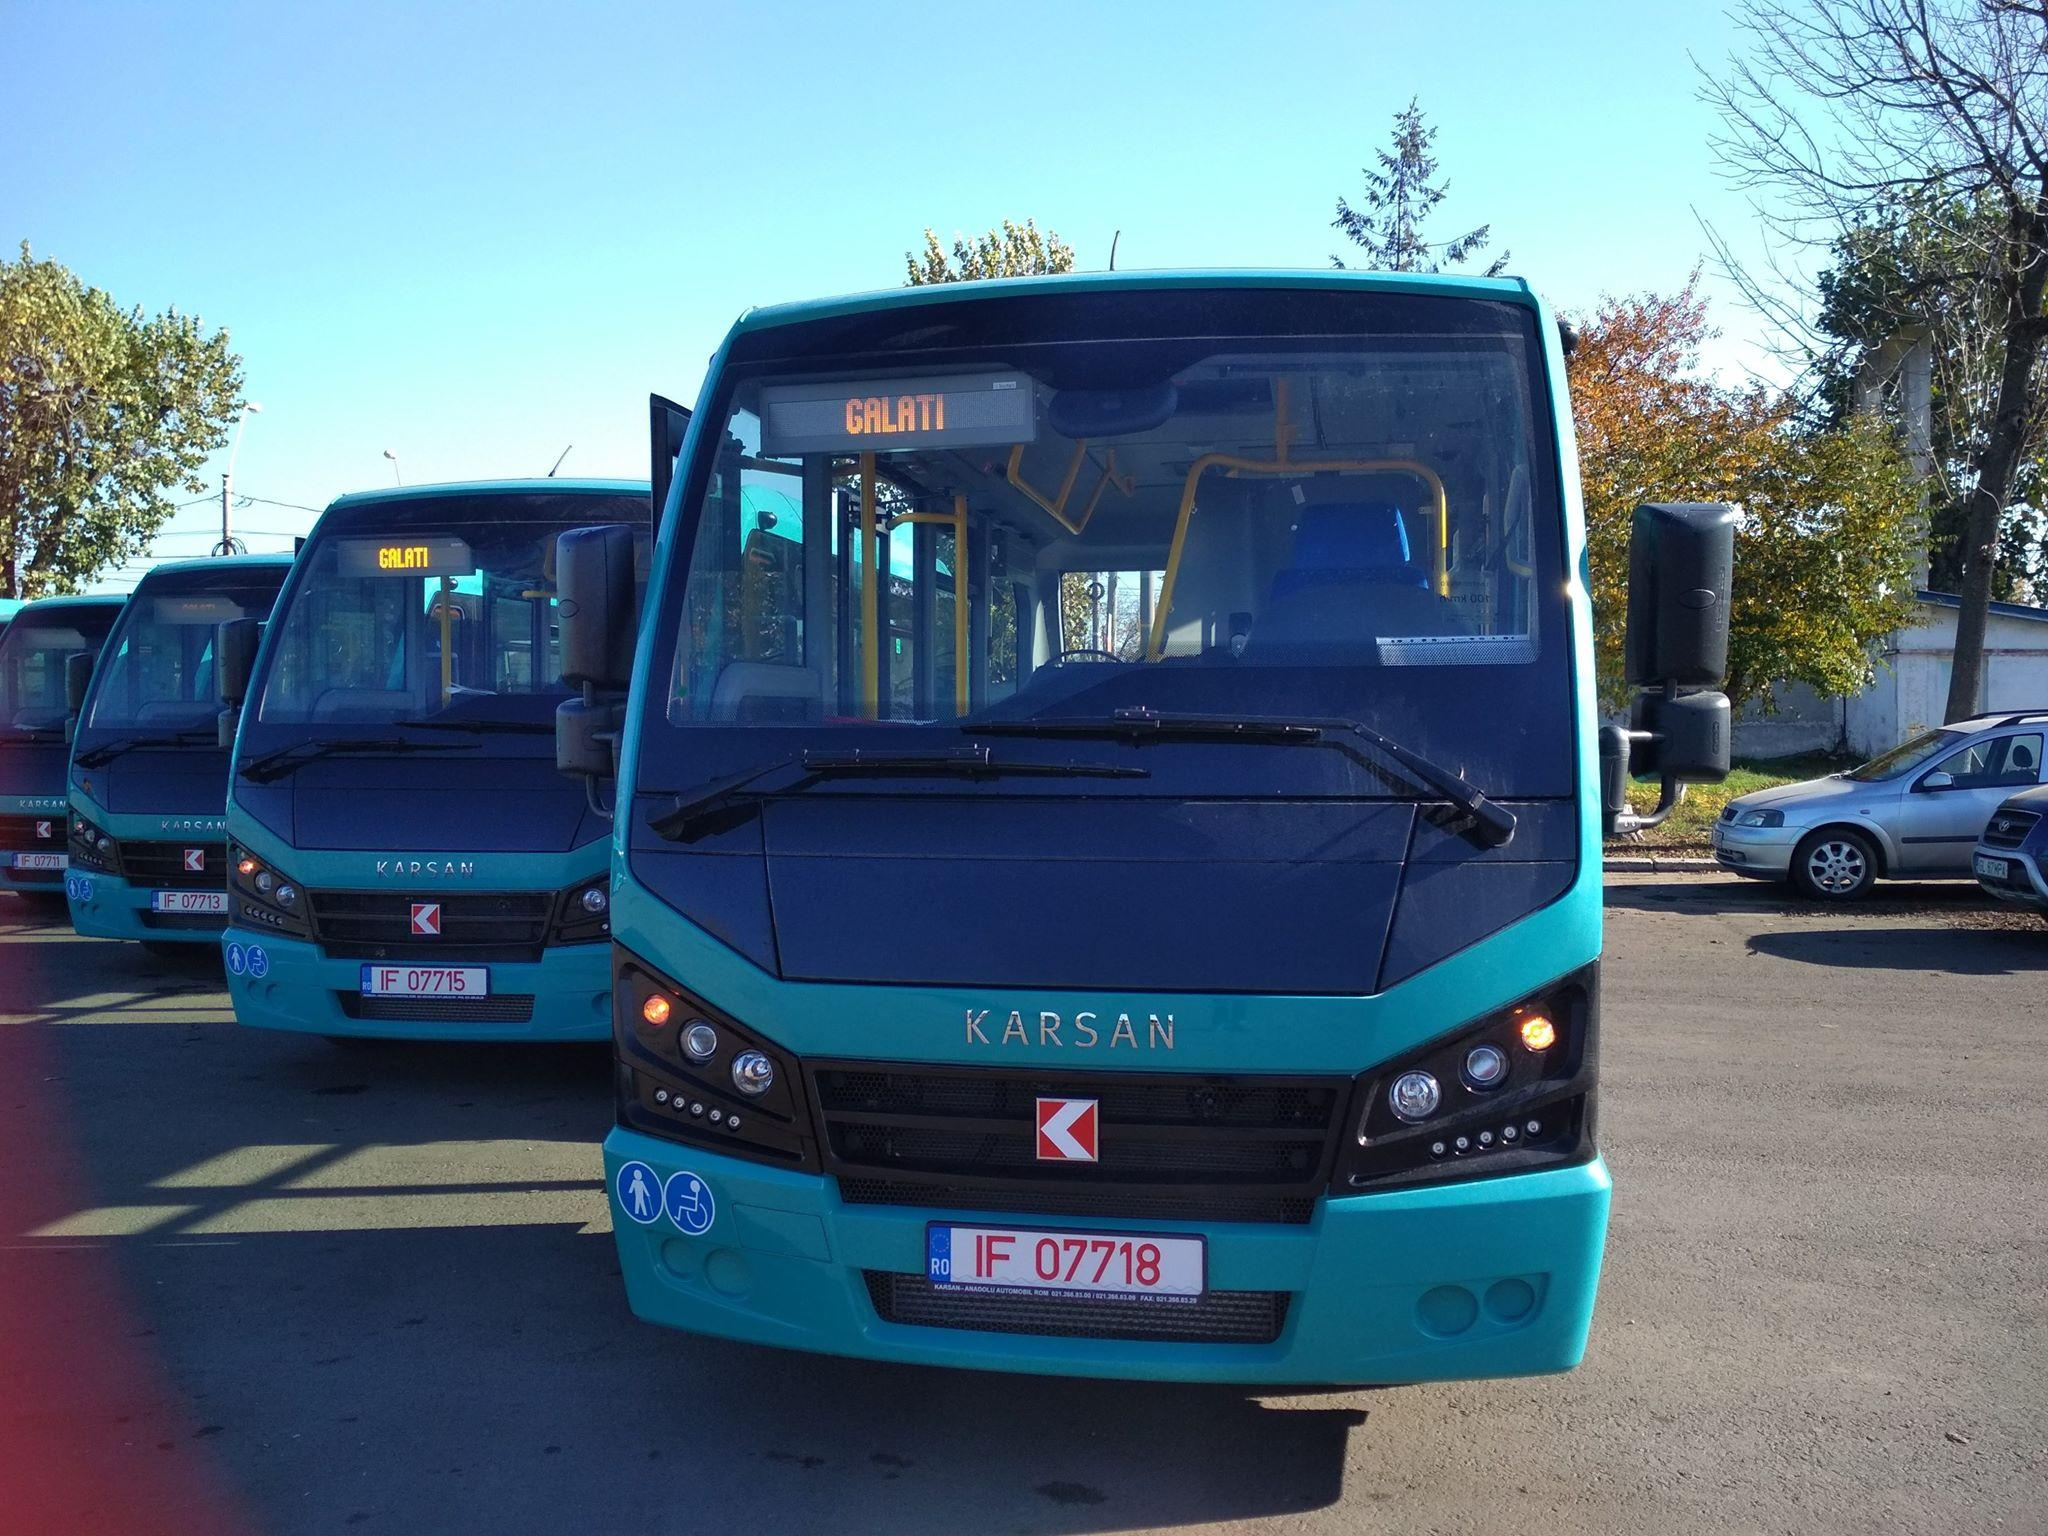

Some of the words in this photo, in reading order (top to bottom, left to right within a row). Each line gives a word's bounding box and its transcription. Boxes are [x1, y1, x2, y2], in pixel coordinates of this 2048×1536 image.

[846, 393, 944, 435] GALATI
[379, 547, 429, 569] GALATI
[19, 800, 67, 808] KARSAN
[161, 820, 227, 831] KARSAN
[376, 861, 474, 878] KARSAN
[164, 893, 177, 909] IF
[181, 894, 221, 910] 07713
[380, 969, 400, 991] IF
[408, 970, 466, 992] 07715
[966, 1008, 1175, 1050] KARSAN
[931, 1257, 950, 1276] RO
[975, 1234, 1016, 1278] IF
[1035, 1237, 1161, 1286] 07718
